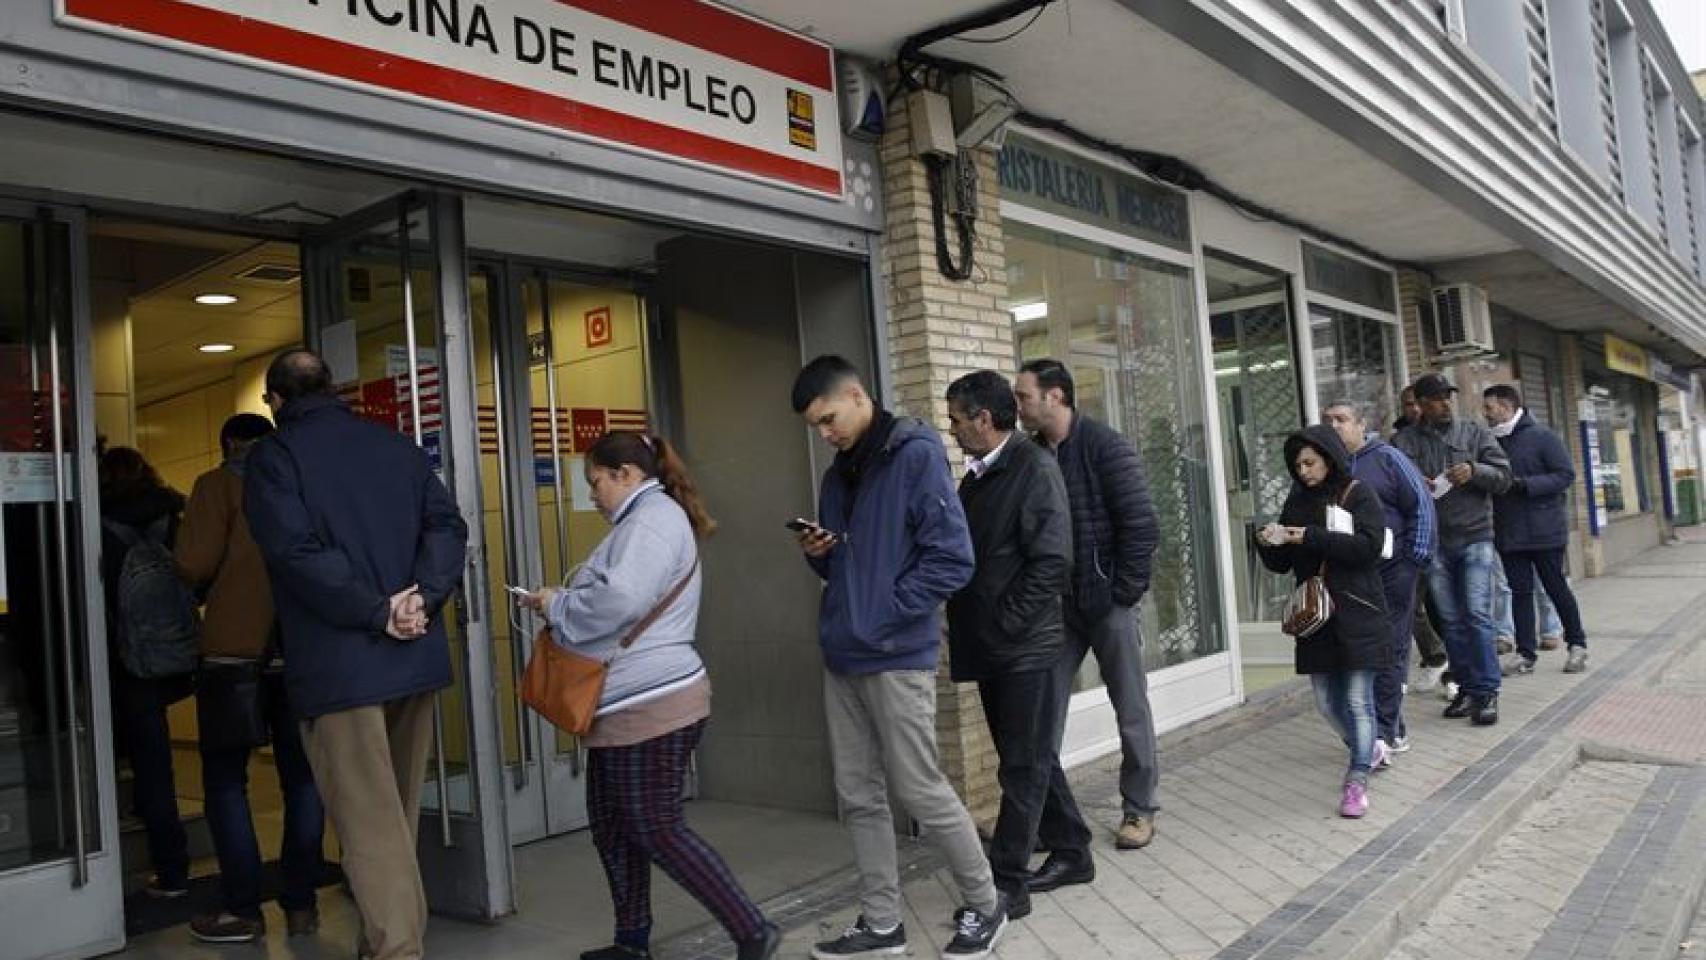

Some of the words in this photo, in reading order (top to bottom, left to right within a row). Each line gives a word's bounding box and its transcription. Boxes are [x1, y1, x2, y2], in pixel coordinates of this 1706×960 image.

[308, 0, 499, 54] CINA
[513, 15, 579, 76] DE
[592, 39, 757, 125] EMPLEO
